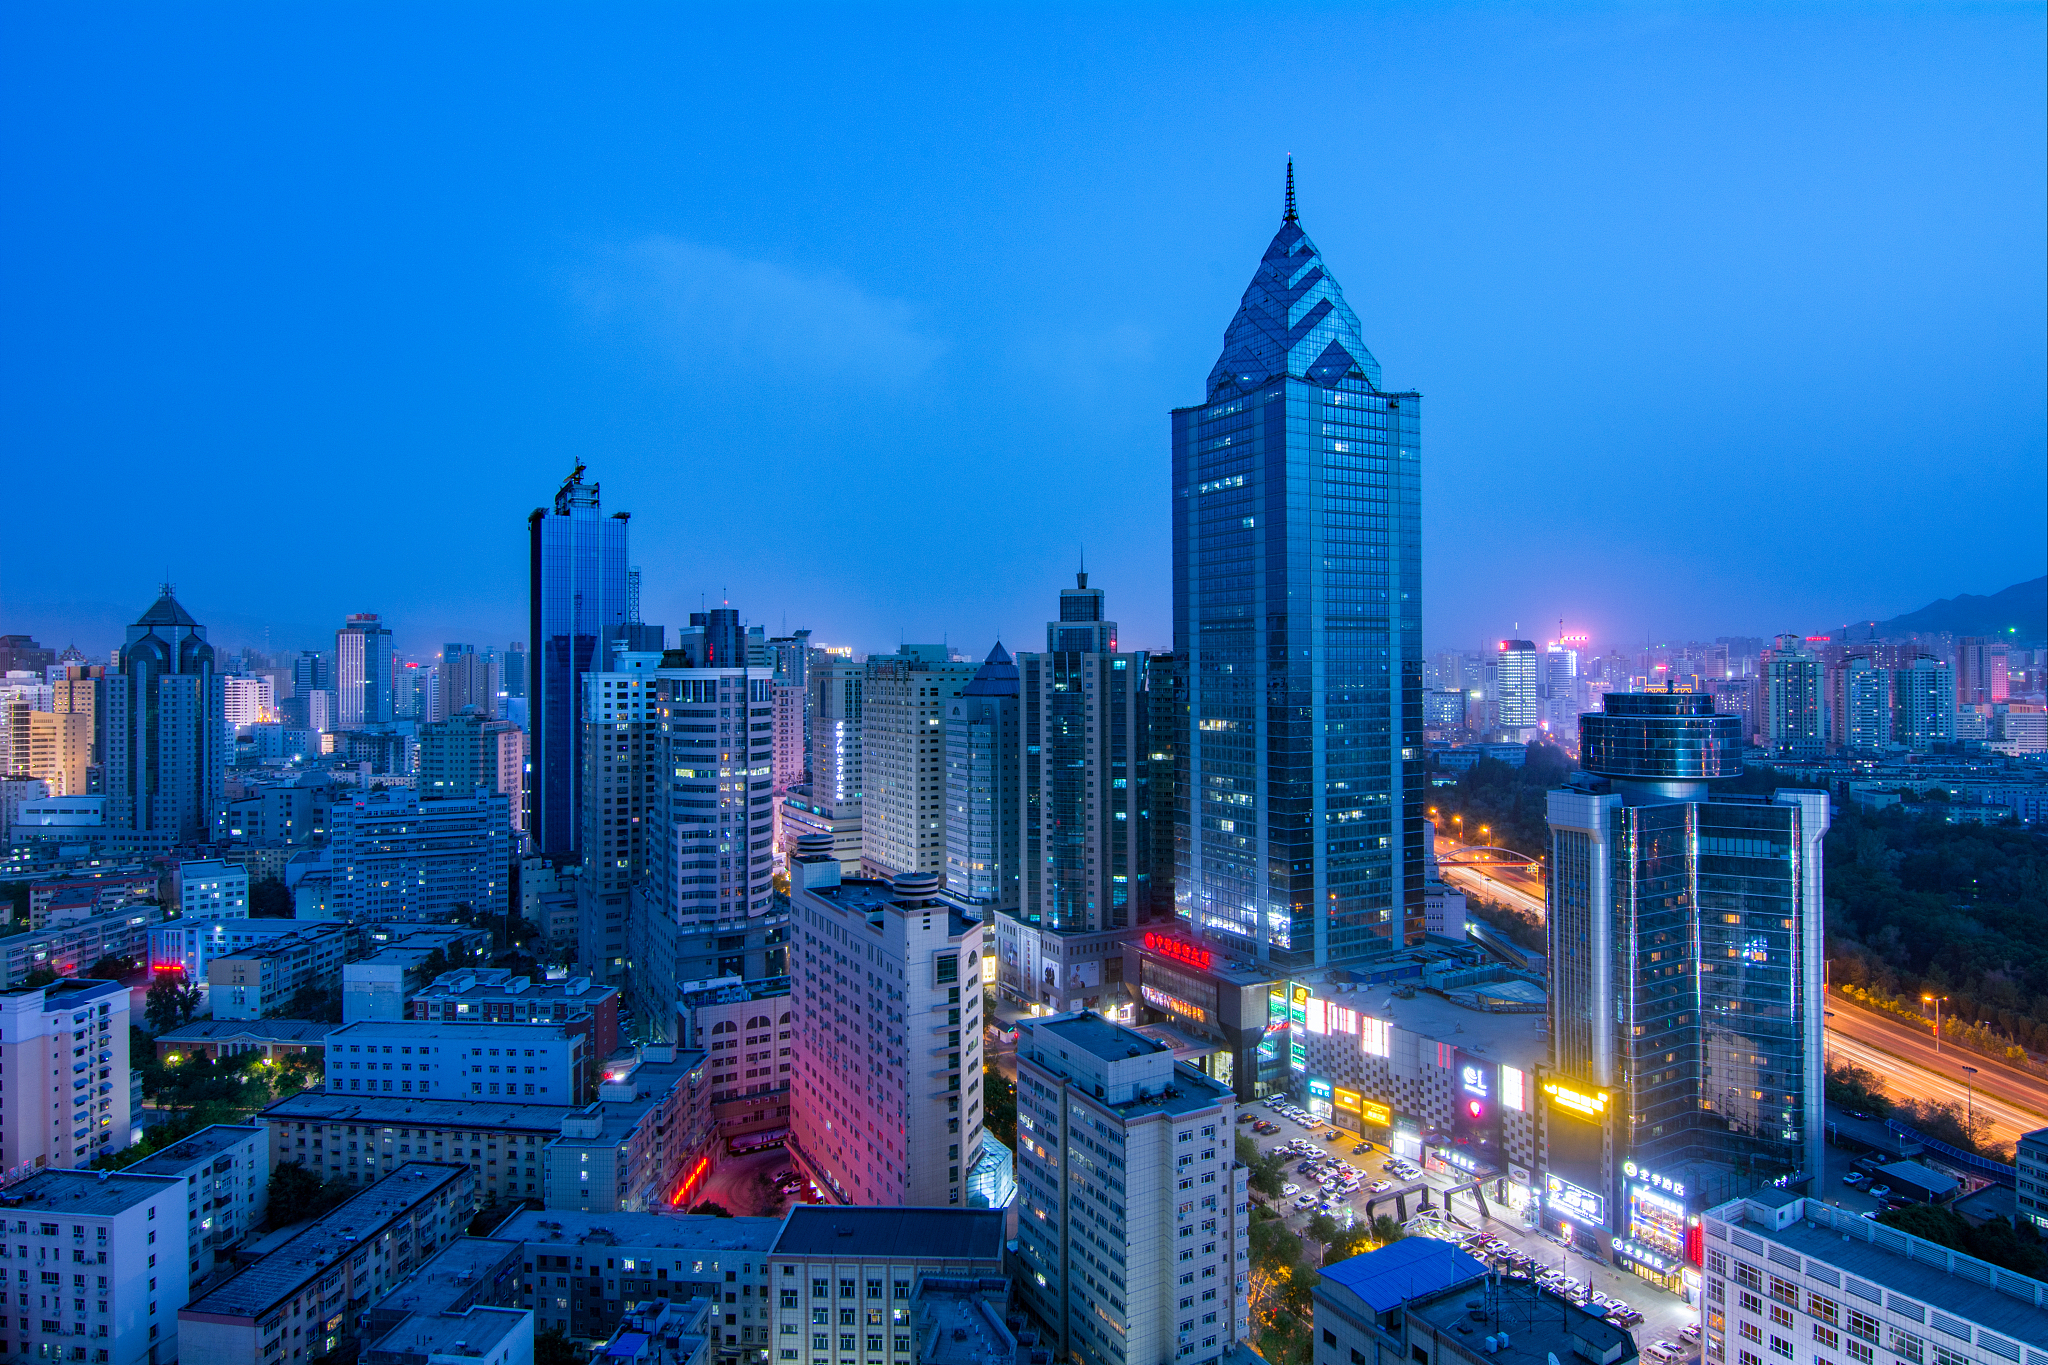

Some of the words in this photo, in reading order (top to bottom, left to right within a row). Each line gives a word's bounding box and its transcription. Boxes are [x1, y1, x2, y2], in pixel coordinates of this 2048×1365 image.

[1639, 1169, 1685, 1196] 全季酒店
[1625, 1244, 1663, 1269] 全季酒店
